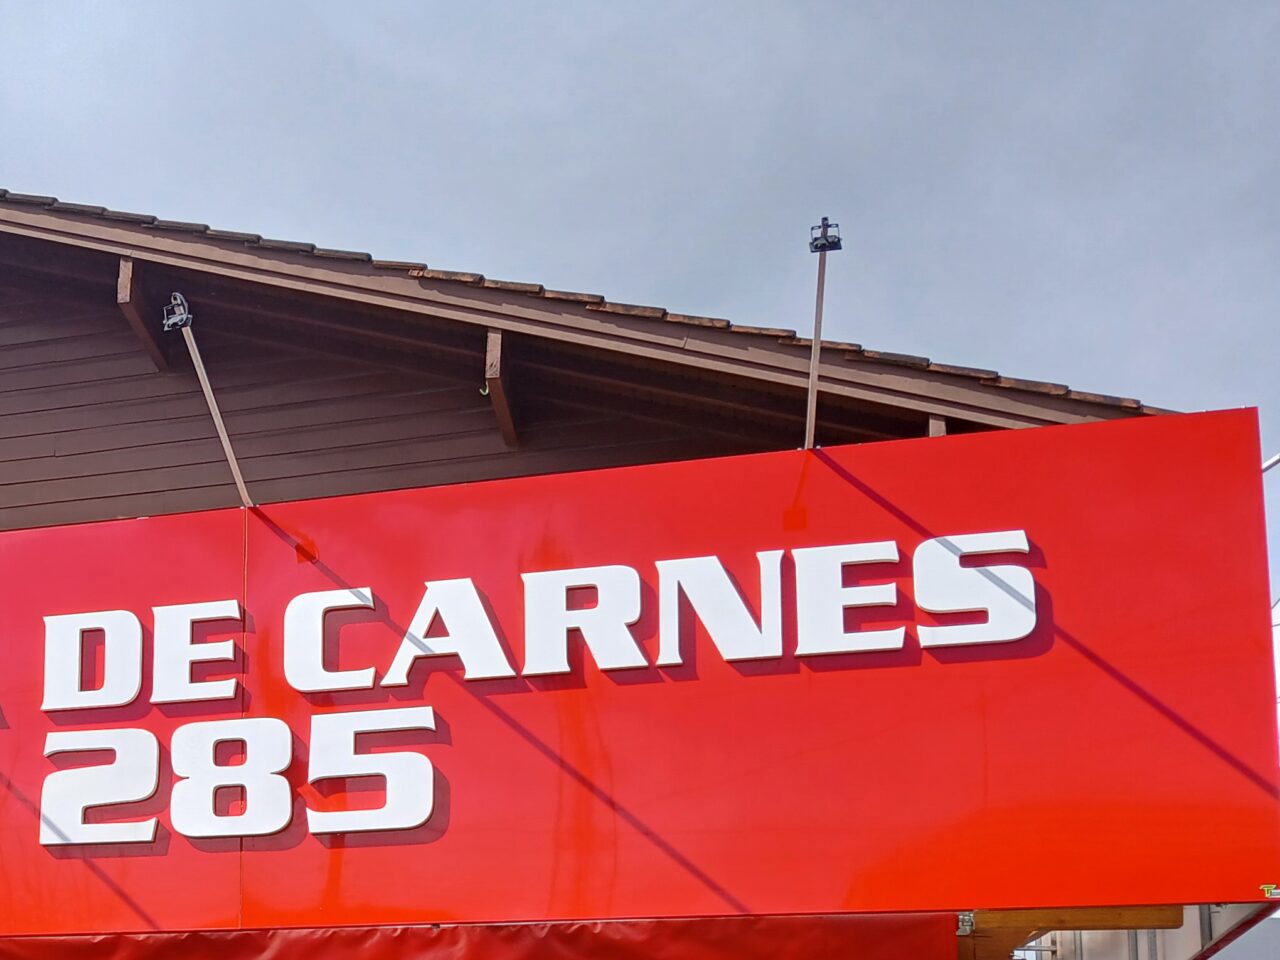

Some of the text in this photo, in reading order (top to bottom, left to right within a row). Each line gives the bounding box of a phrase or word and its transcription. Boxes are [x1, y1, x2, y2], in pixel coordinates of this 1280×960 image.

[40, 599, 242, 712] DE
[283, 529, 1038, 694] CARNES
[39, 705, 437, 847] 285
